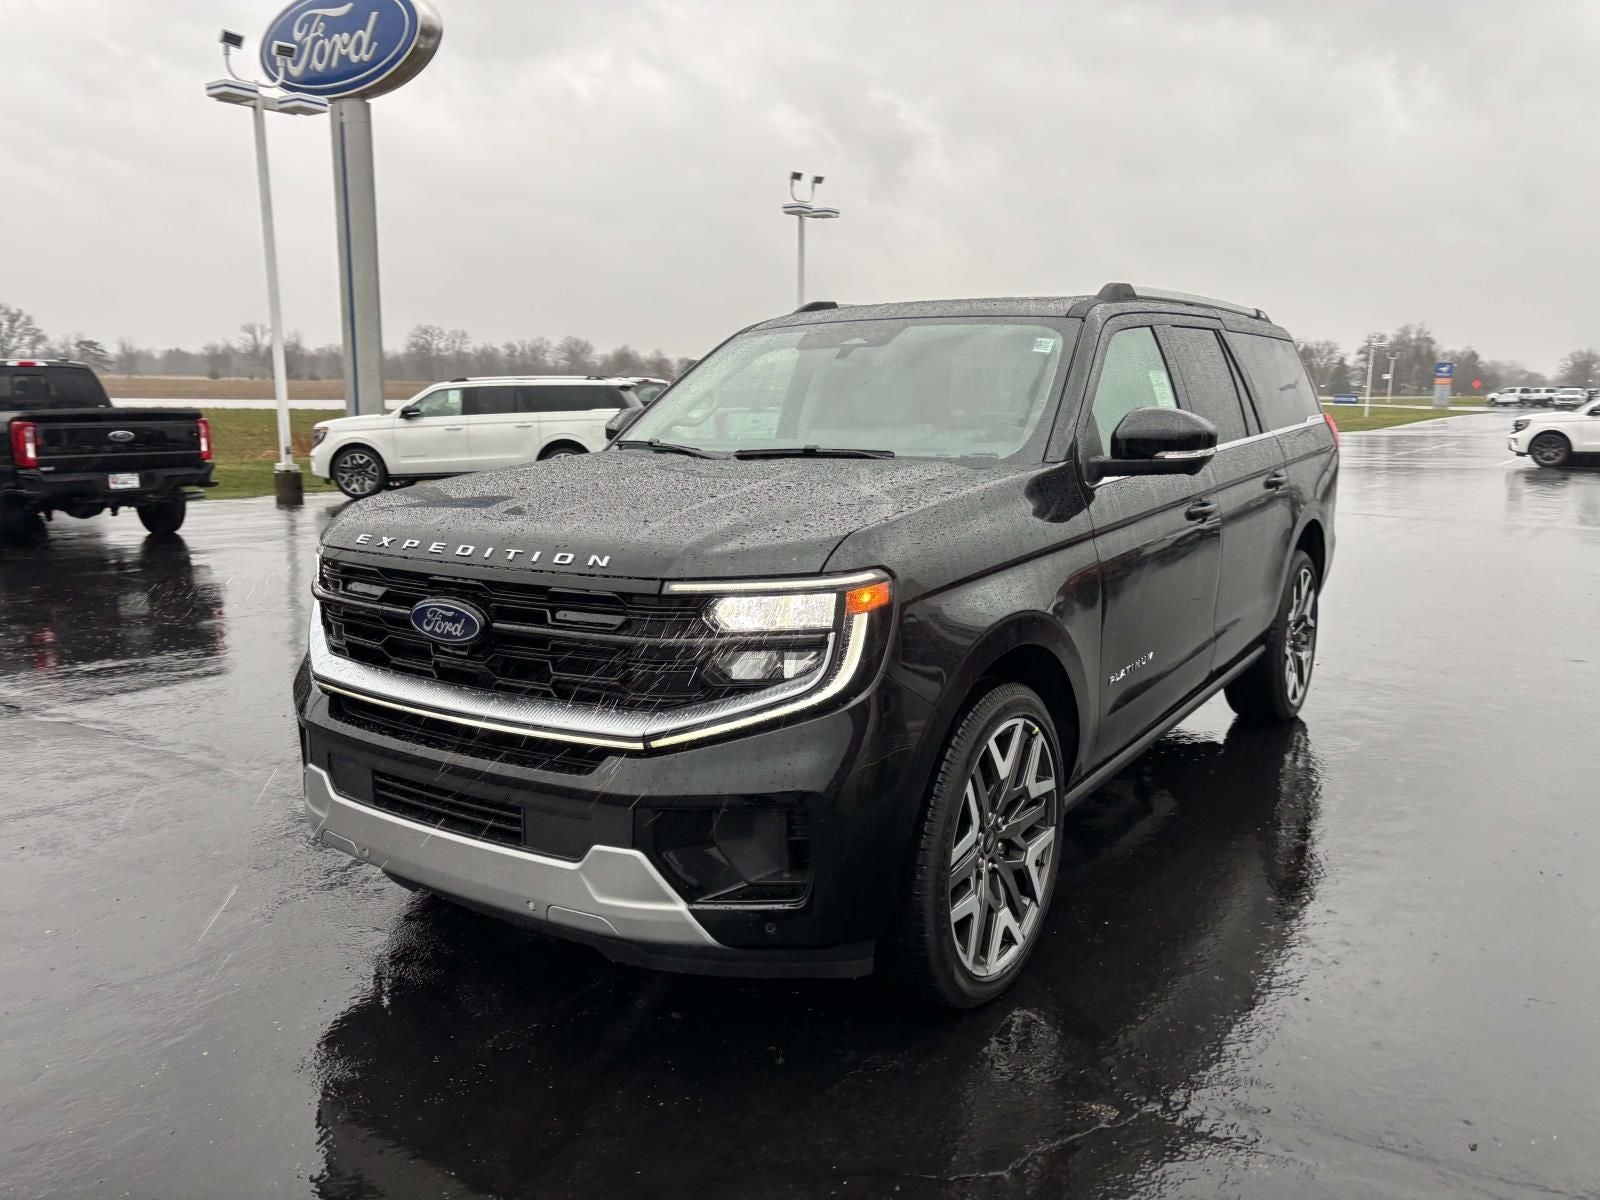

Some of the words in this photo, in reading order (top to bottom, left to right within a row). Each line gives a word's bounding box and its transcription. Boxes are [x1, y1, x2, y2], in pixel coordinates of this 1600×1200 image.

[287, 2, 380, 77] Ford
[355, 533, 611, 568] EXPEDITION
[423, 607, 465, 637] Ford
